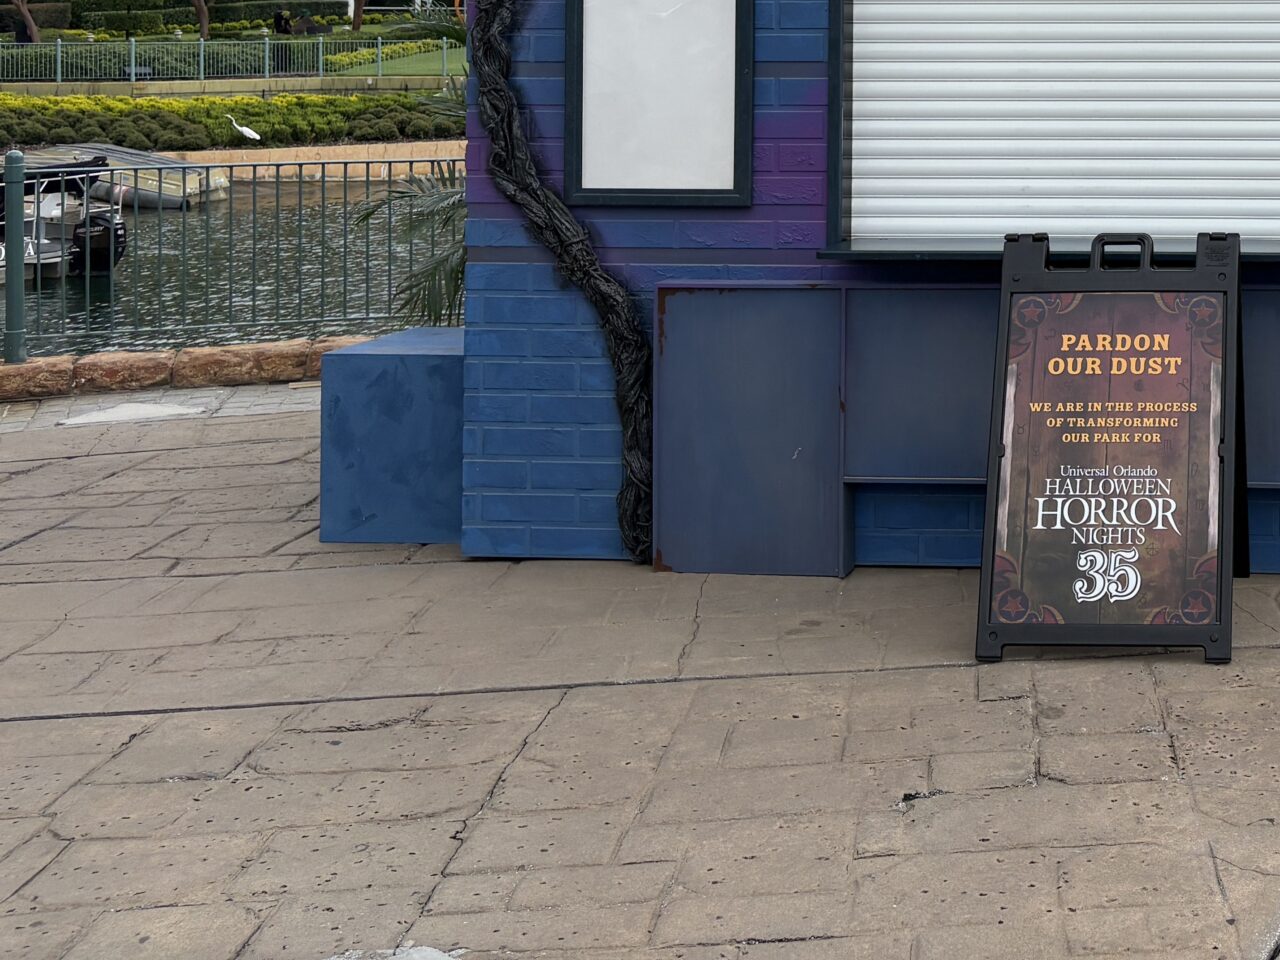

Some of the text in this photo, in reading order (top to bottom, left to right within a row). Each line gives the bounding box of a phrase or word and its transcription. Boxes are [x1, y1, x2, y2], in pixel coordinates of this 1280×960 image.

[1060, 333, 1170, 352] PARDON
[1047, 357, 1182, 375] OUR DUST
[1029, 402, 1198, 412] WE ARE IN THE PROCESS
[1046, 417, 1178, 428] OF TRANSFORMING
[1062, 433, 1161, 443] OUR PARK FOR
[1060, 465, 1158, 477] Universal Orlando
[1043, 478, 1172, 496] HALLOWEEN
[1032, 497, 1182, 536] HORROR
[1071, 527, 1146, 545] NIGHTS
[1072, 547, 1141, 603] 35
